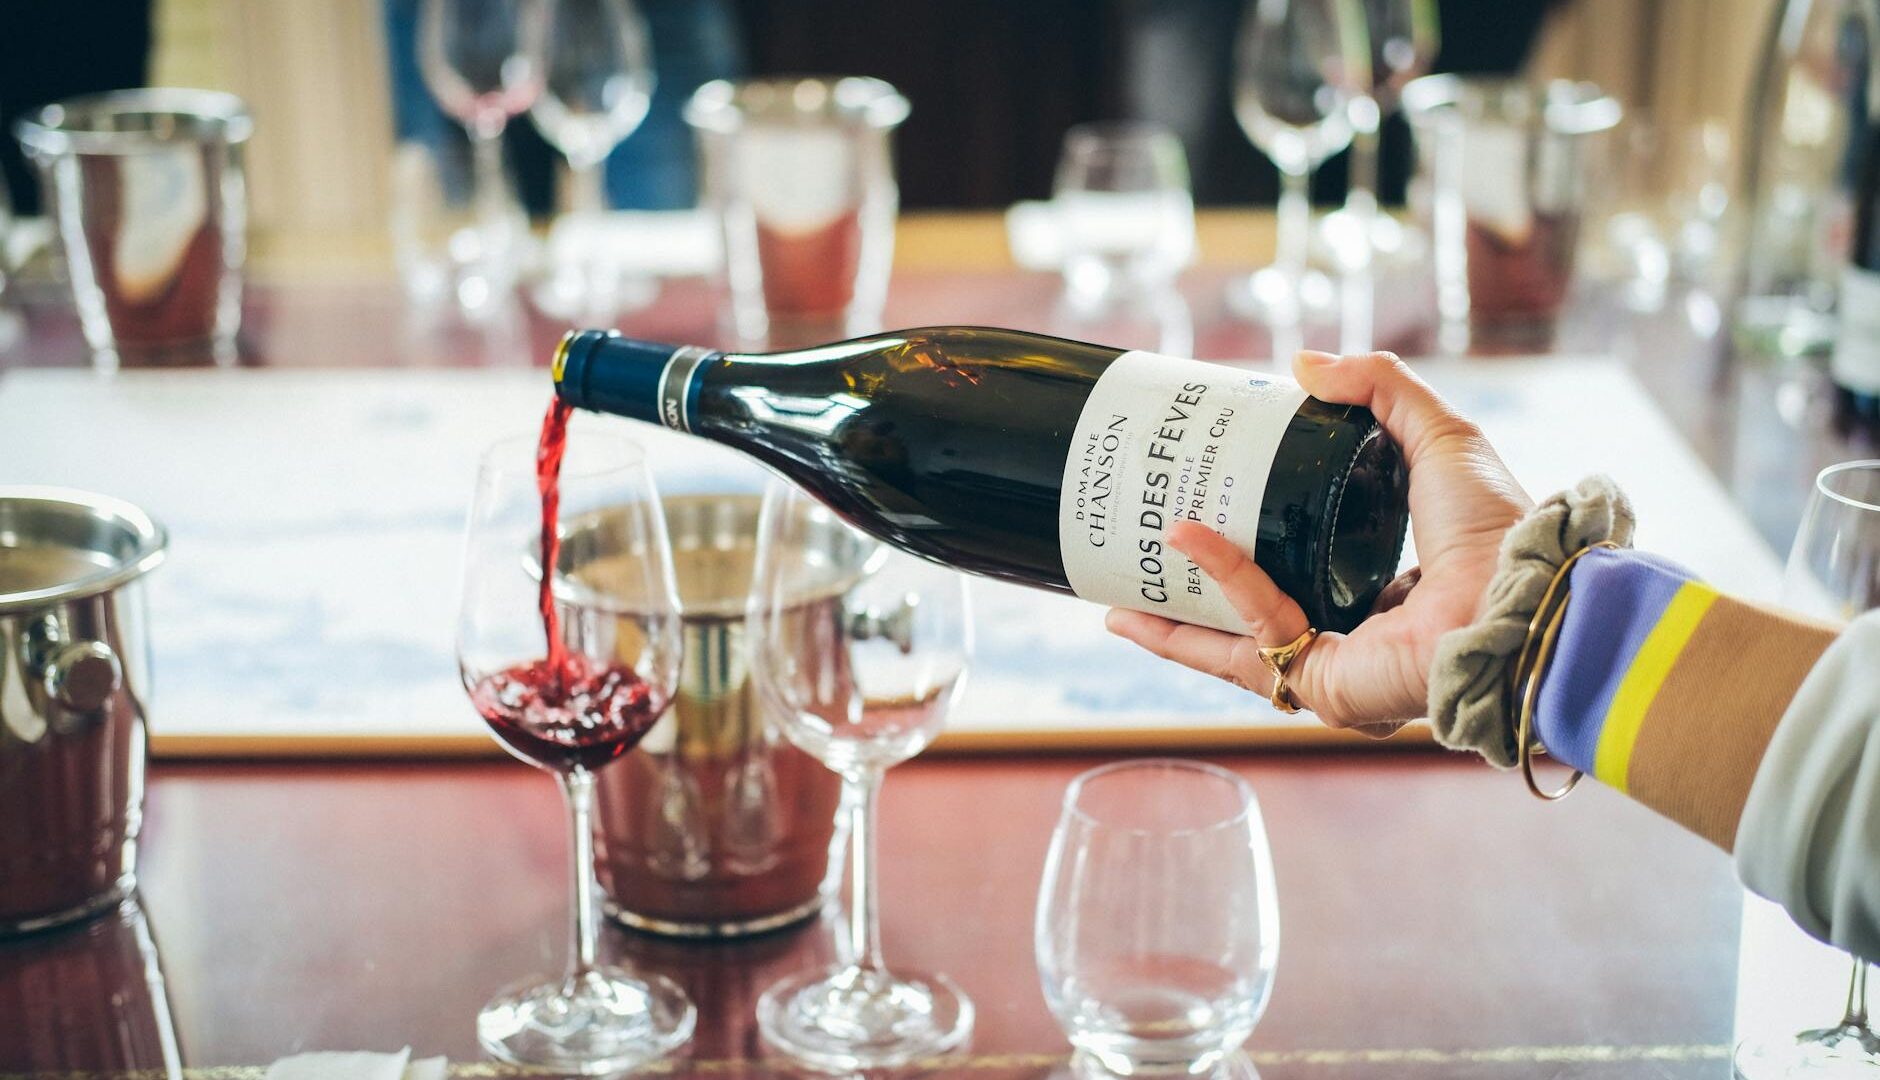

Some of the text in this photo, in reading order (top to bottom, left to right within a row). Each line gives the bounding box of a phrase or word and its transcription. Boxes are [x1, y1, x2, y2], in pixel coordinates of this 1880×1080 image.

[666, 399, 680, 430] ON
[1076, 432, 1100, 521] DOMAINE
[1089, 413, 1129, 548] CHANSON
[1139, 381, 1208, 604] CLOS DES FÈVES
[1174, 456, 1195, 522] NOPOLE
[1187, 407, 1235, 596] BEA PREMIER CRU
